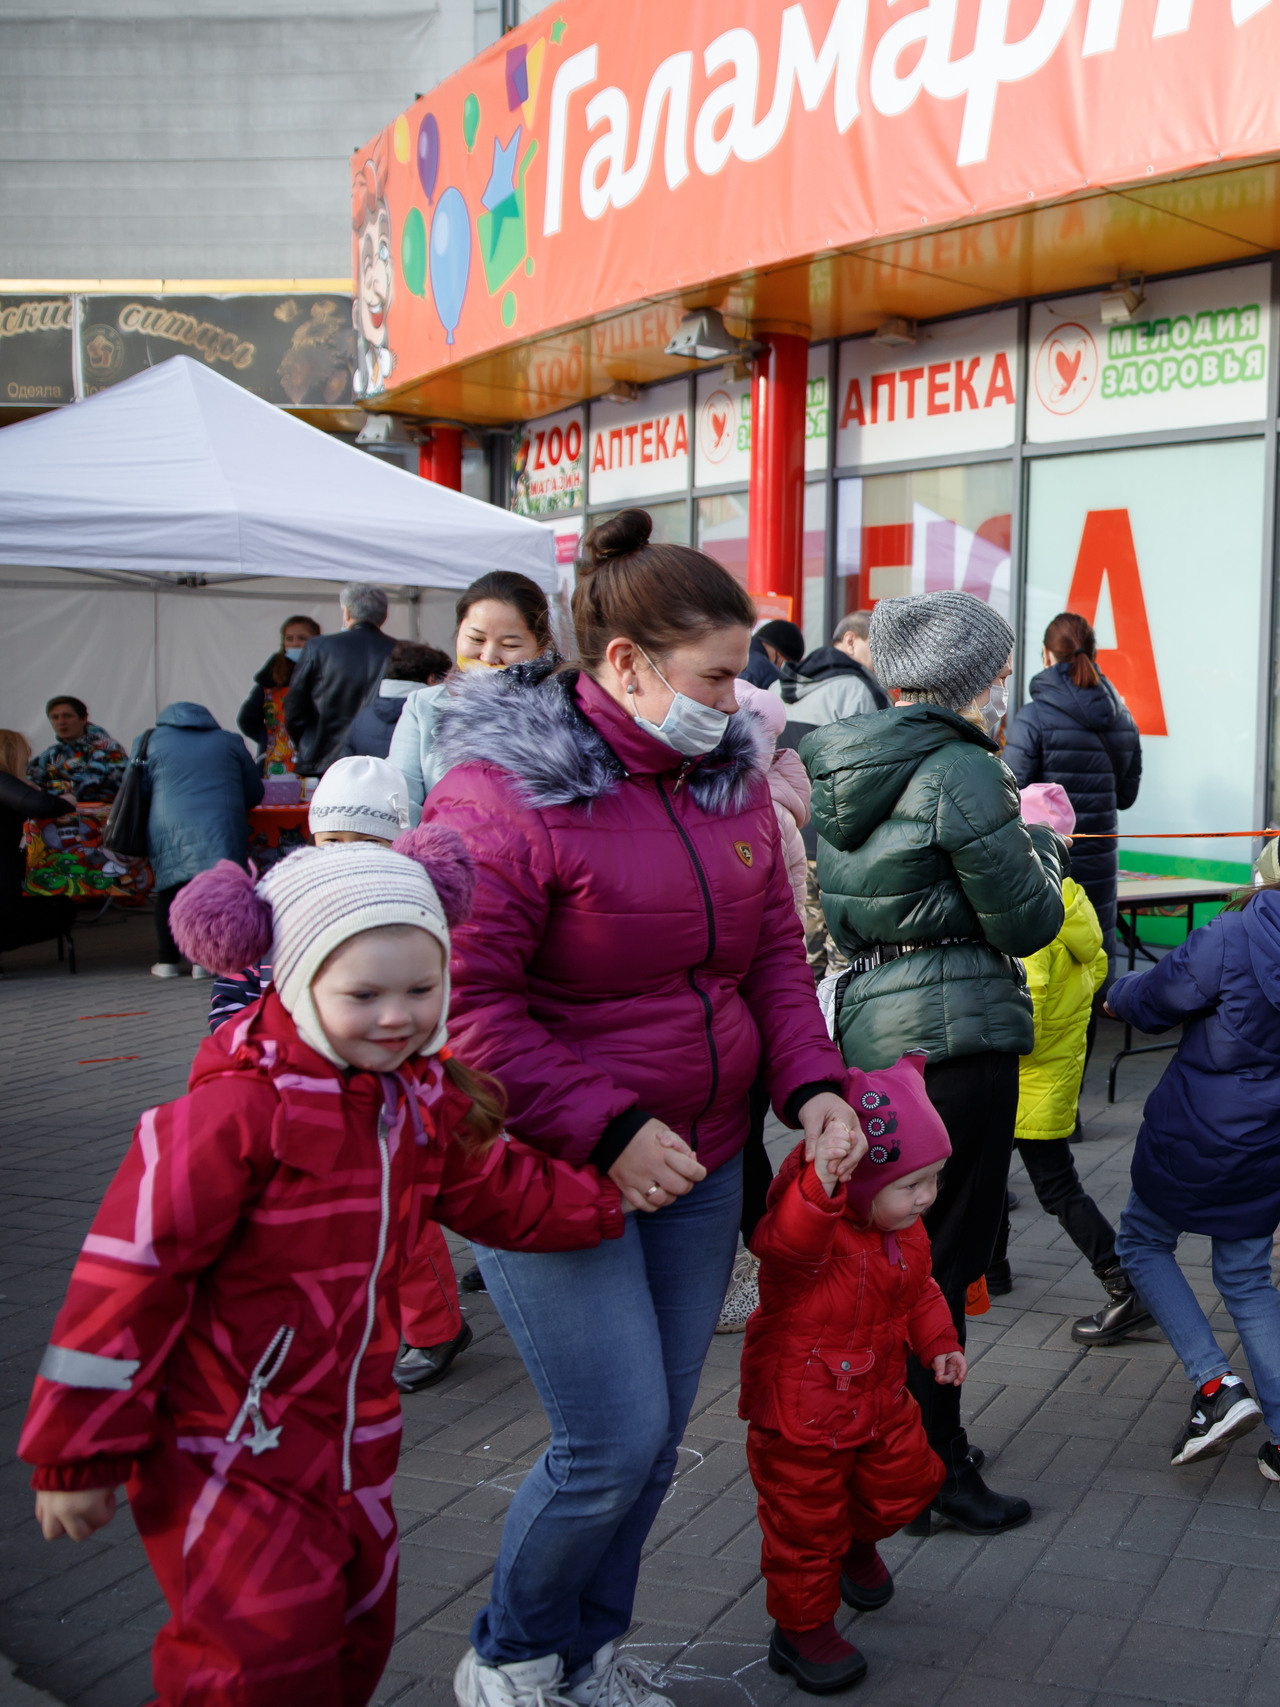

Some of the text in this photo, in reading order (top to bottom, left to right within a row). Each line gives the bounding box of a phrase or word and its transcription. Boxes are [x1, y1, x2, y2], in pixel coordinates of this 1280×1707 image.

[1108, 304, 1260, 360] МЕЛОДИЯ
[7, 382, 62, 399] Одеяла
[839, 352, 1016, 429] АПТЕКА
[1101, 345, 1266, 399] ЗДОРОВЬЯ
[533, 420, 582, 471] ZOO
[590, 413, 689, 474] АПТЕКА
[530, 472, 581, 497] МАГАЗИН
